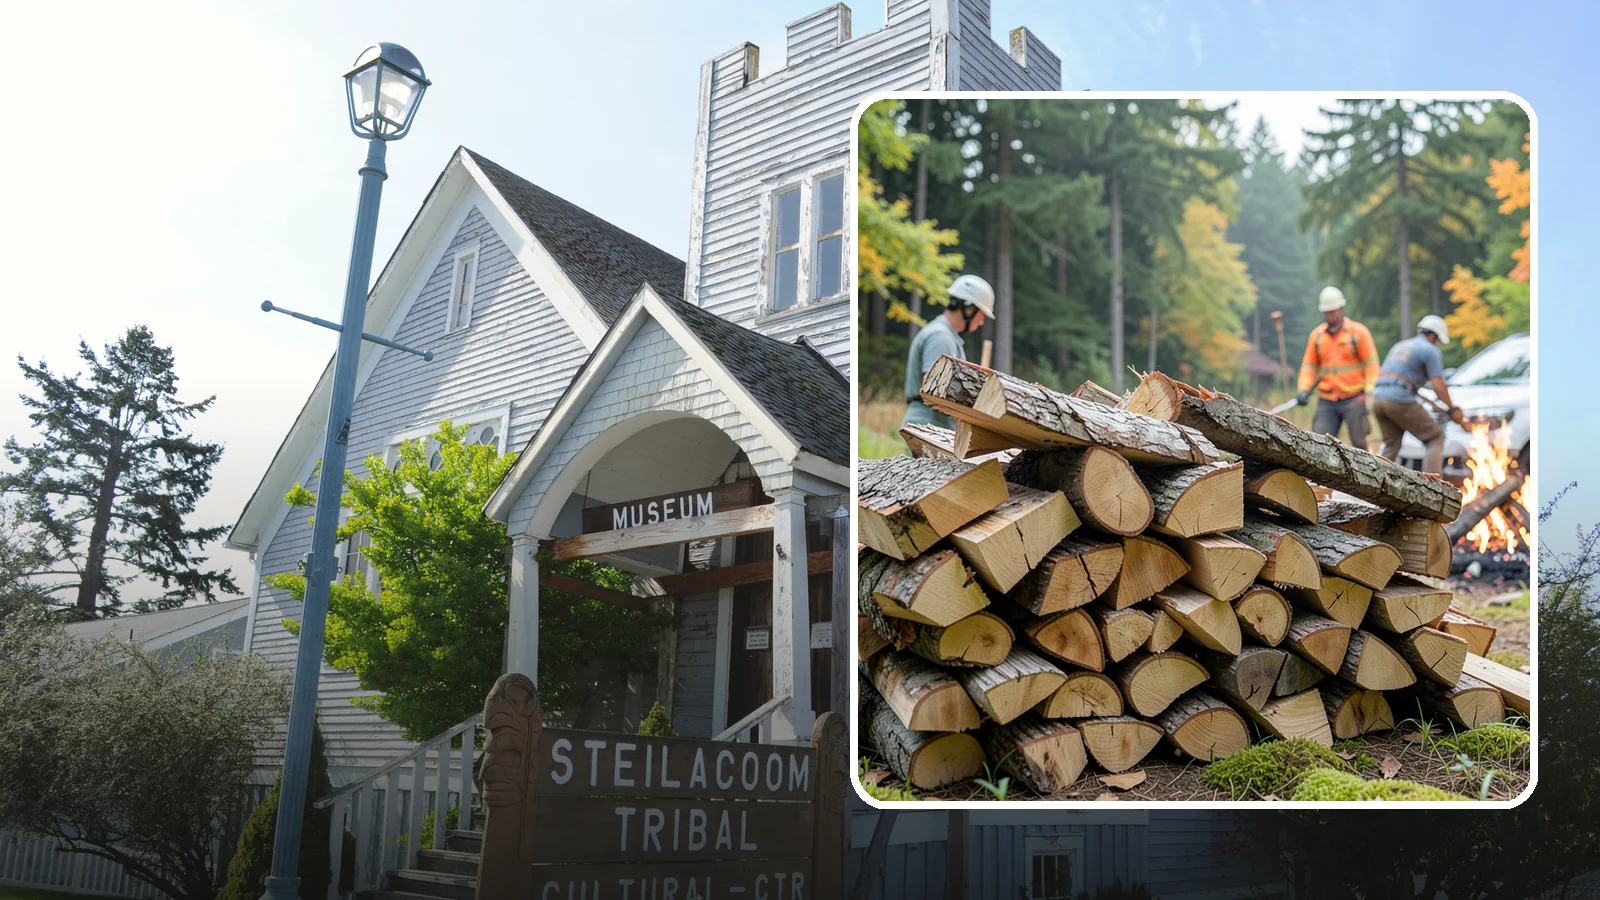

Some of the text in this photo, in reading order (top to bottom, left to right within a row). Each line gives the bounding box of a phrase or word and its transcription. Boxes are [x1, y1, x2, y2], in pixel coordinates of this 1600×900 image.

[613, 491, 713, 531] MUSEUM
[551, 738, 809, 792] STEILACOOM
[615, 806, 758, 852] TRIBAL
